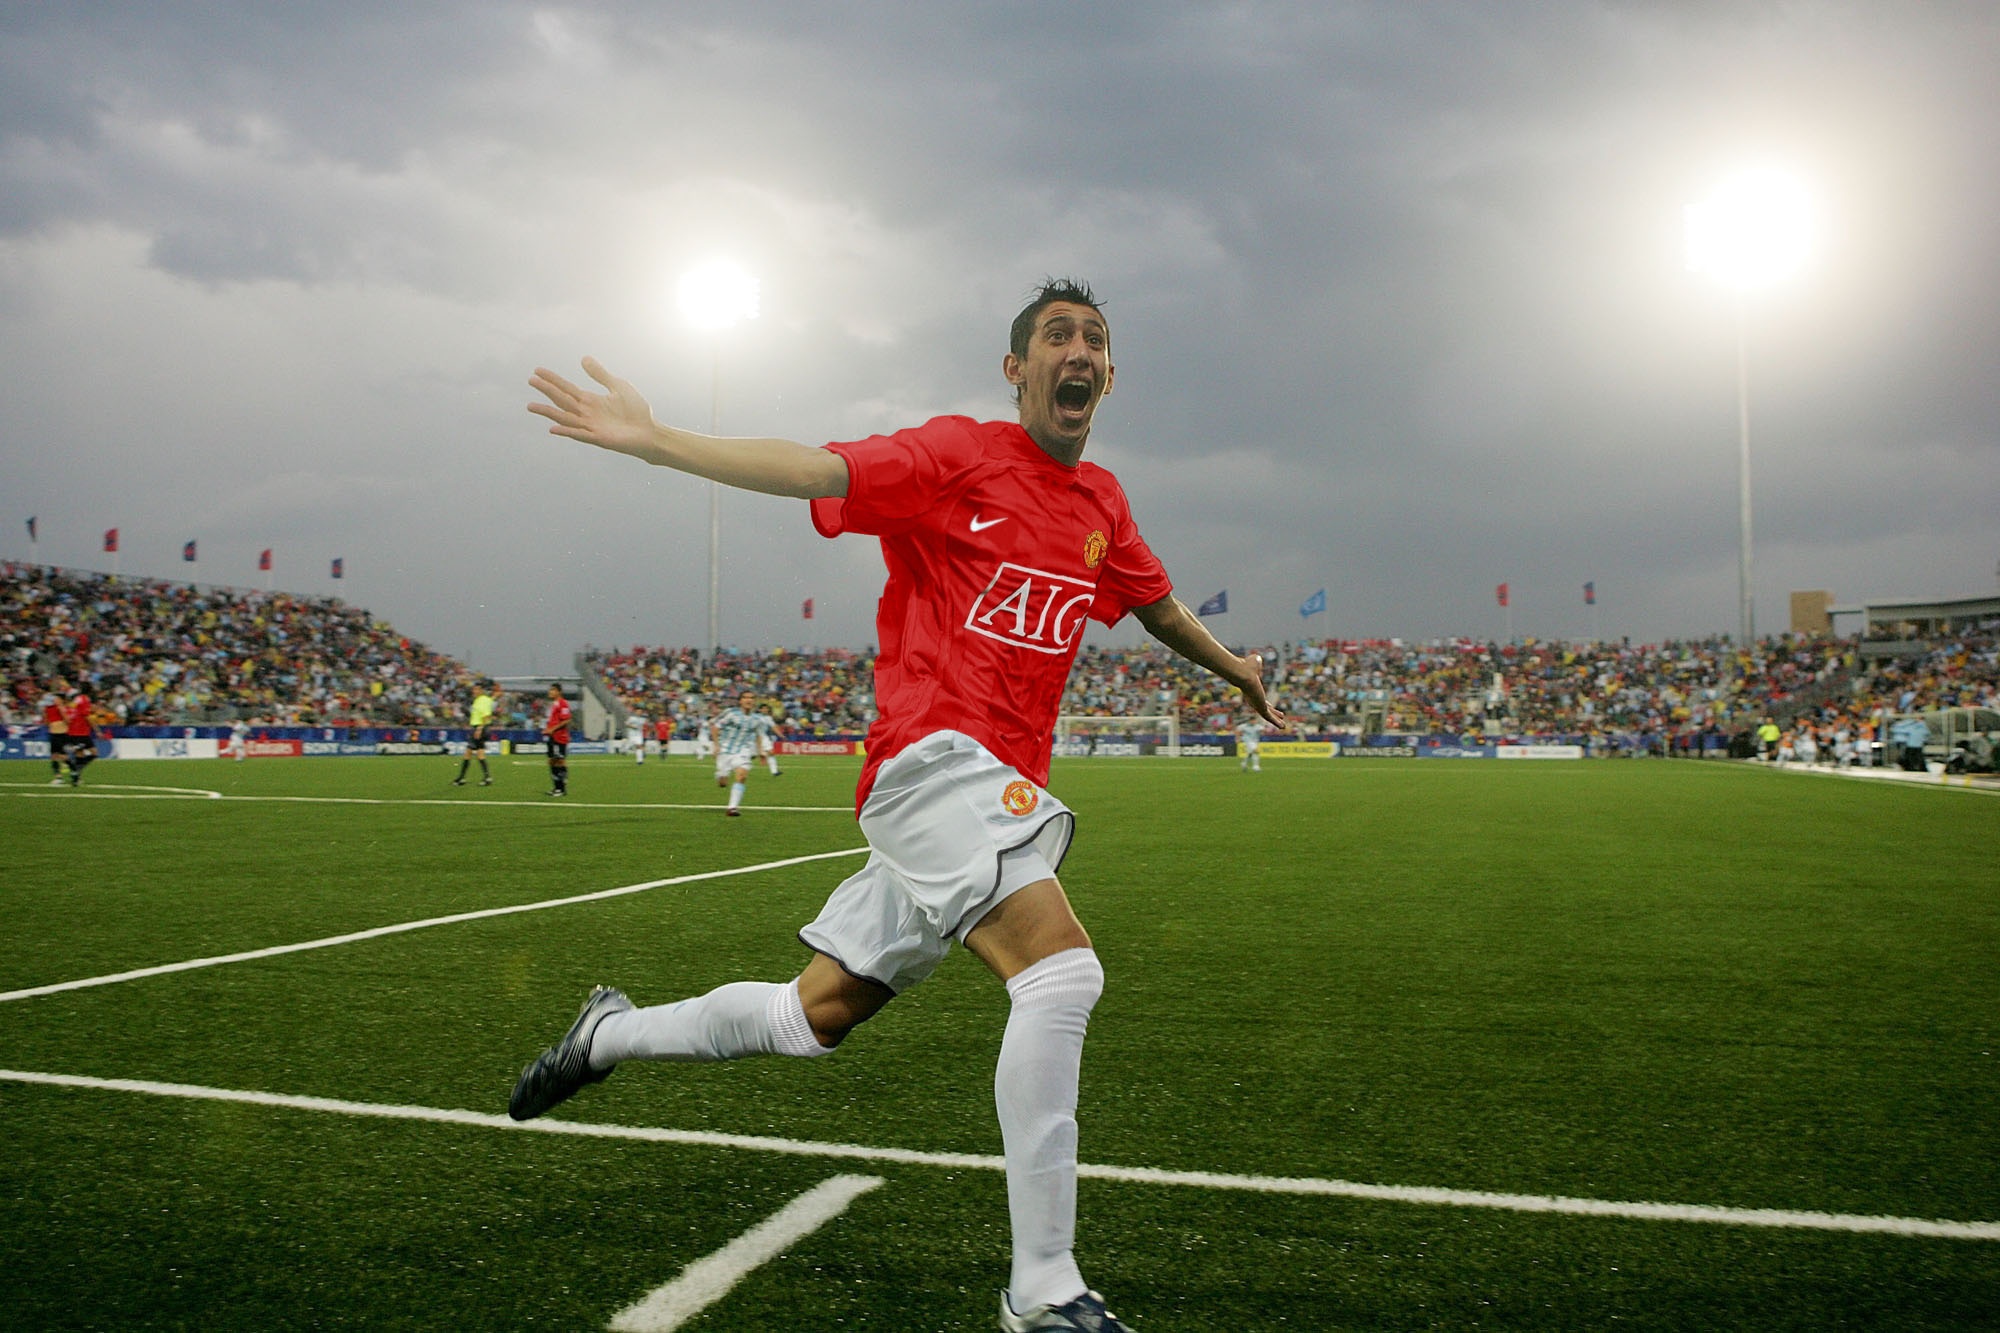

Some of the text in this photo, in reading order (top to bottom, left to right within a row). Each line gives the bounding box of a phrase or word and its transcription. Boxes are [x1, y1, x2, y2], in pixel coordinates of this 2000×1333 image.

[977, 577, 1096, 646] AIG
[153, 739, 188, 757] VISA
[782, 742, 849, 755] Fly Emirates
[1183, 744, 1225, 756] adidas
[1342, 746, 1415, 757] WINNERS
